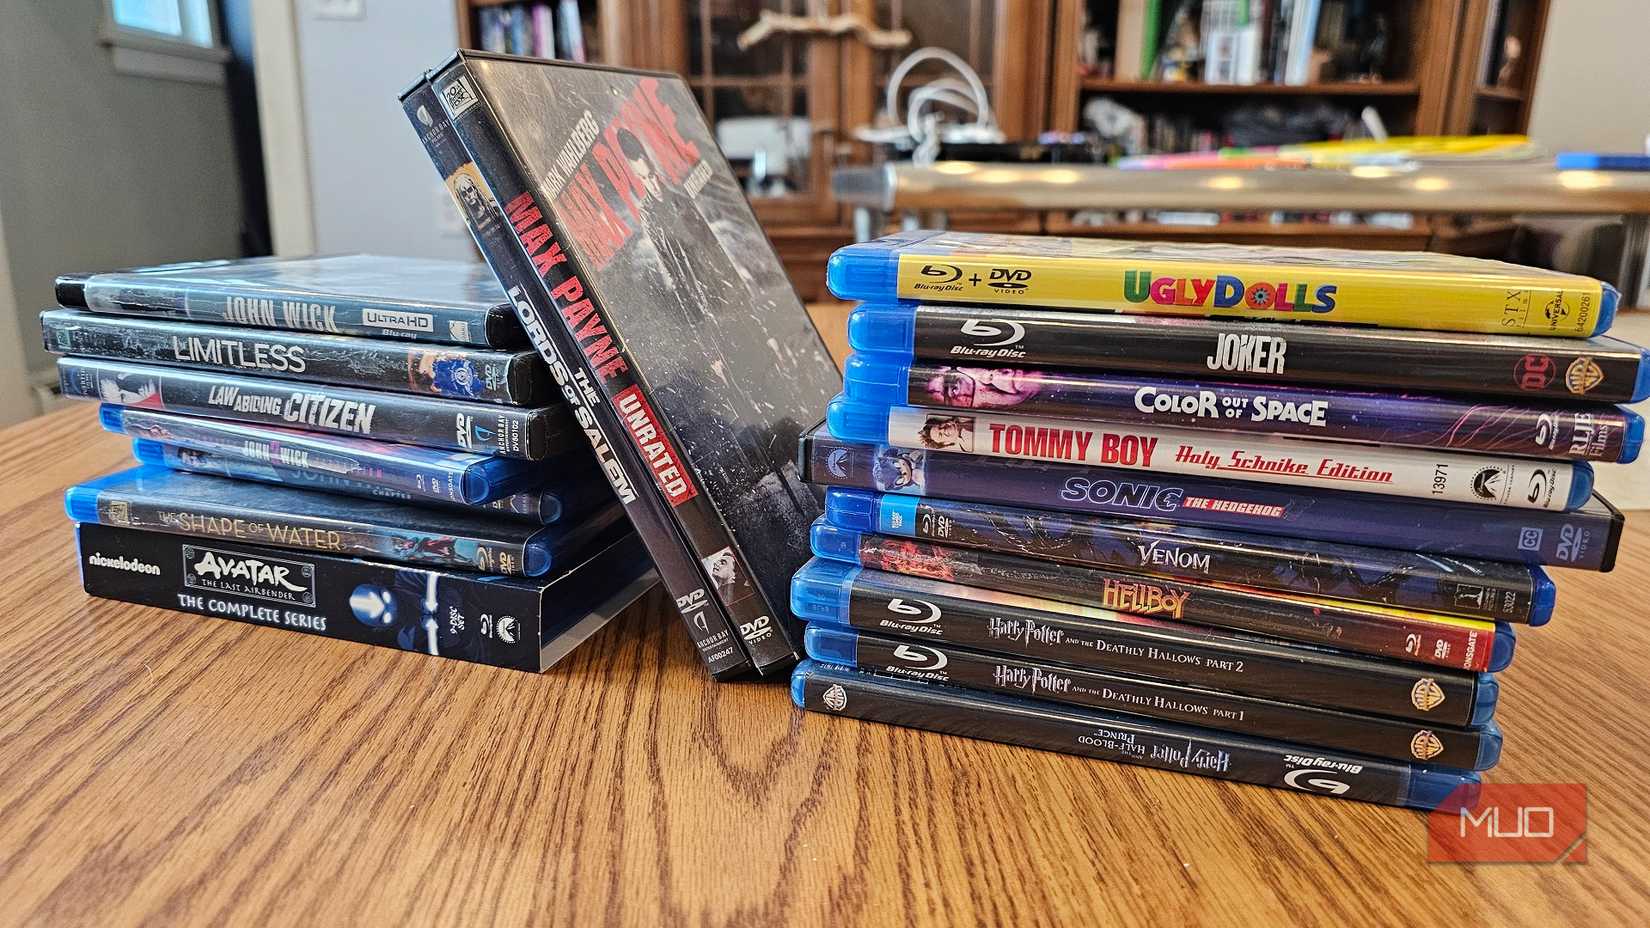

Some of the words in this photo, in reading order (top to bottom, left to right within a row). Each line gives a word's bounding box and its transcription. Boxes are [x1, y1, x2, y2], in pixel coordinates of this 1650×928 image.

[541, 165, 567, 200] MARK
[556, 109, 600, 180] WAHLBERG
[989, 268, 1032, 281] DVD
[222, 296, 277, 328] JOHN
[283, 299, 339, 334] WICK
[1501, 288, 1521, 328] STX
[1550, 290, 1564, 331] UNIVERSAL
[1574, 291, 1591, 333] 64200261
[382, 328, 417, 340] Blu-ray
[505, 191, 568, 278] MAX
[550, 275, 629, 385] PAYNE
[619, 393, 688, 498] UNRATED
[172, 335, 306, 373] LIMITLESS
[950, 345, 999, 359] Blu-ray
[997, 348, 1027, 359] Disc
[1206, 332, 1288, 375] JOKER
[573, 367, 601, 408] THE
[1520, 353, 1549, 391] DC
[208, 385, 240, 408] LAW
[234, 397, 283, 416] ABIDING
[284, 391, 377, 435] CITIZEN
[508, 285, 571, 385] LORDS
[574, 406, 638, 506] SALEM
[1134, 386, 1220, 419] COLOR
[1222, 396, 1249, 408] OUT
[1251, 395, 1329, 428] SPACE
[498, 414, 506, 428] BAY
[1225, 408, 1243, 419] OF
[456, 412, 468, 449] DVD
[497, 429, 507, 455] ANCHOR
[1589, 424, 1608, 457] Films
[242, 440, 271, 461] JOHN
[280, 447, 310, 469] WICK
[989, 423, 1094, 462] TOMMY
[1100, 432, 1159, 468] BOY
[1175, 445, 1221, 470] Holy
[1316, 457, 1393, 483] Edition
[1432, 463, 1449, 495] 13971
[1061, 476, 1184, 512] SONIC
[1184, 496, 1210, 509] THE
[1213, 499, 1283, 518] HEDGEHOG
[158, 511, 178, 524] THE
[179, 512, 247, 539] SHAPE
[248, 522, 264, 534] OF
[267, 524, 342, 551] WATER
[937, 515, 945, 538] DVD
[1523, 529, 1538, 547] CC
[1556, 523, 1574, 561] DVD
[89, 551, 161, 576] nickelodeon
[193, 551, 308, 592] AVATAR
[500, 551, 508, 575] DVD
[1137, 539, 1211, 575] VENOM
[201, 577, 219, 589] THE
[220, 579, 243, 593] LAST
[244, 584, 296, 601] AIRBENDER
[676, 588, 705, 608] DVD
[1103, 577, 1191, 620] HELLBOY
[177, 593, 205, 611] THE
[208, 598, 281, 624] COMPLETE
[284, 610, 328, 632] SERIES
[740, 615, 770, 636] DVD
[879, 619, 922, 634] Blu-ray
[919, 625, 944, 636] Disc
[717, 629, 730, 640] BAY
[748, 632, 773, 645] VIDEO
[987, 617, 1025, 642] Harry
[1024, 619, 1065, 648] Potter
[1065, 637, 1080, 645] AND
[1081, 640, 1094, 648] THE
[1096, 639, 1145, 657] DEATHLY
[1148, 647, 1201, 665] HALLOWS
[1206, 658, 1233, 671] PART
[1235, 661, 1244, 673] 2
[1434, 639, 1444, 659] DVD
[1463, 630, 1479, 670] ONSGATE
[886, 664, 929, 679] Blu-ray
[925, 672, 950, 682] Disc
[993, 664, 1032, 689] Harry
[1031, 667, 1072, 696] Potter
[1072, 685, 1087, 693] AND
[1088, 688, 1101, 696] THE
[1102, 687, 1151, 706] DEATHLY
[1154, 696, 1209, 716] HALLOWS
[1213, 708, 1237, 719] PART
[1239, 710, 1245, 722] 1
[1078, 735, 1146, 755] HALF-BLOOD
[1099, 728, 1136, 744] PRINCE
[1150, 738, 1192, 768] Potter
[1191, 748, 1231, 772] Harry
[1283, 753, 1317, 768] Disc
[1315, 756, 1364, 775] Blu-ray
